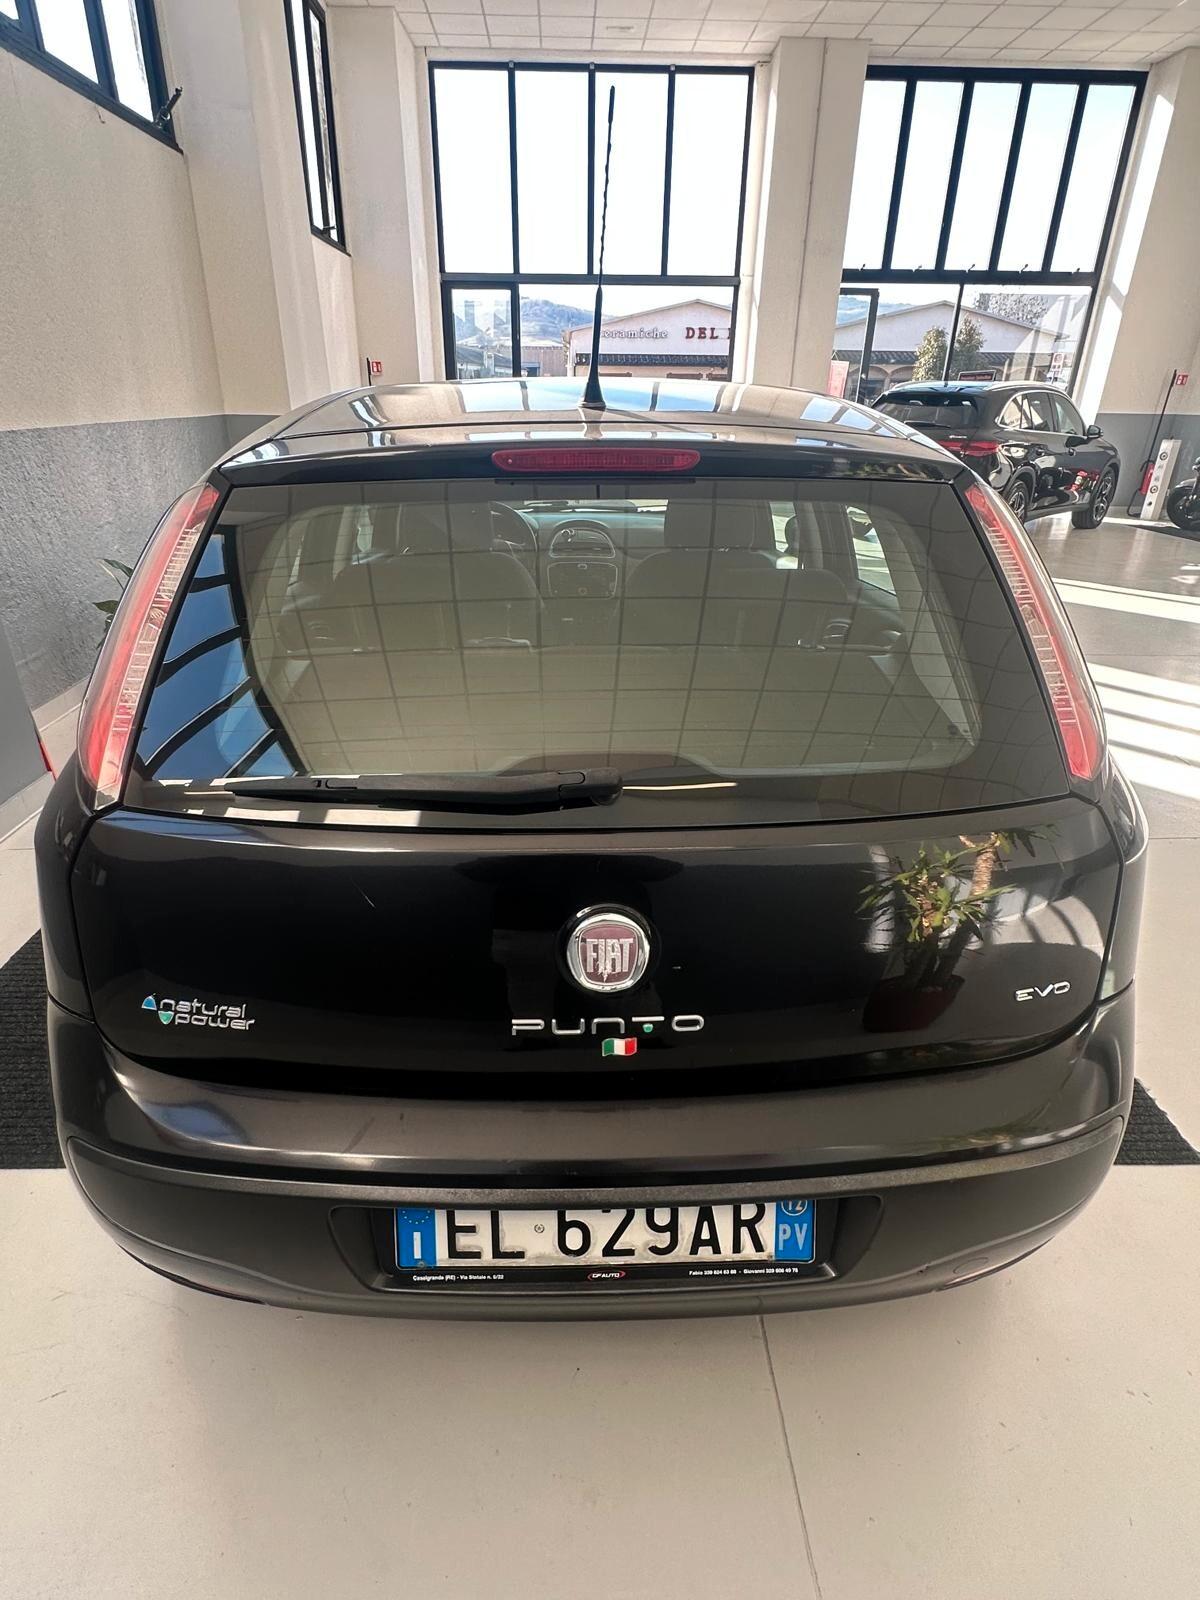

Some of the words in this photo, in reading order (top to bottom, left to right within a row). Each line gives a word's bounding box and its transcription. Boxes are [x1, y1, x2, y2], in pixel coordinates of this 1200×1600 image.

[685, 326, 719, 340] DEL
[586, 937, 634, 974] FIAT
[1015, 981, 1071, 1002] EVO
[159, 998, 247, 1019] natural
[174, 1012, 256, 1031] power
[511, 1014, 705, 1036] PUNTO
[446, 1209, 526, 1260] EL
[557, 1203, 766, 1258] 629AR
[778, 1223, 808, 1251] PV
